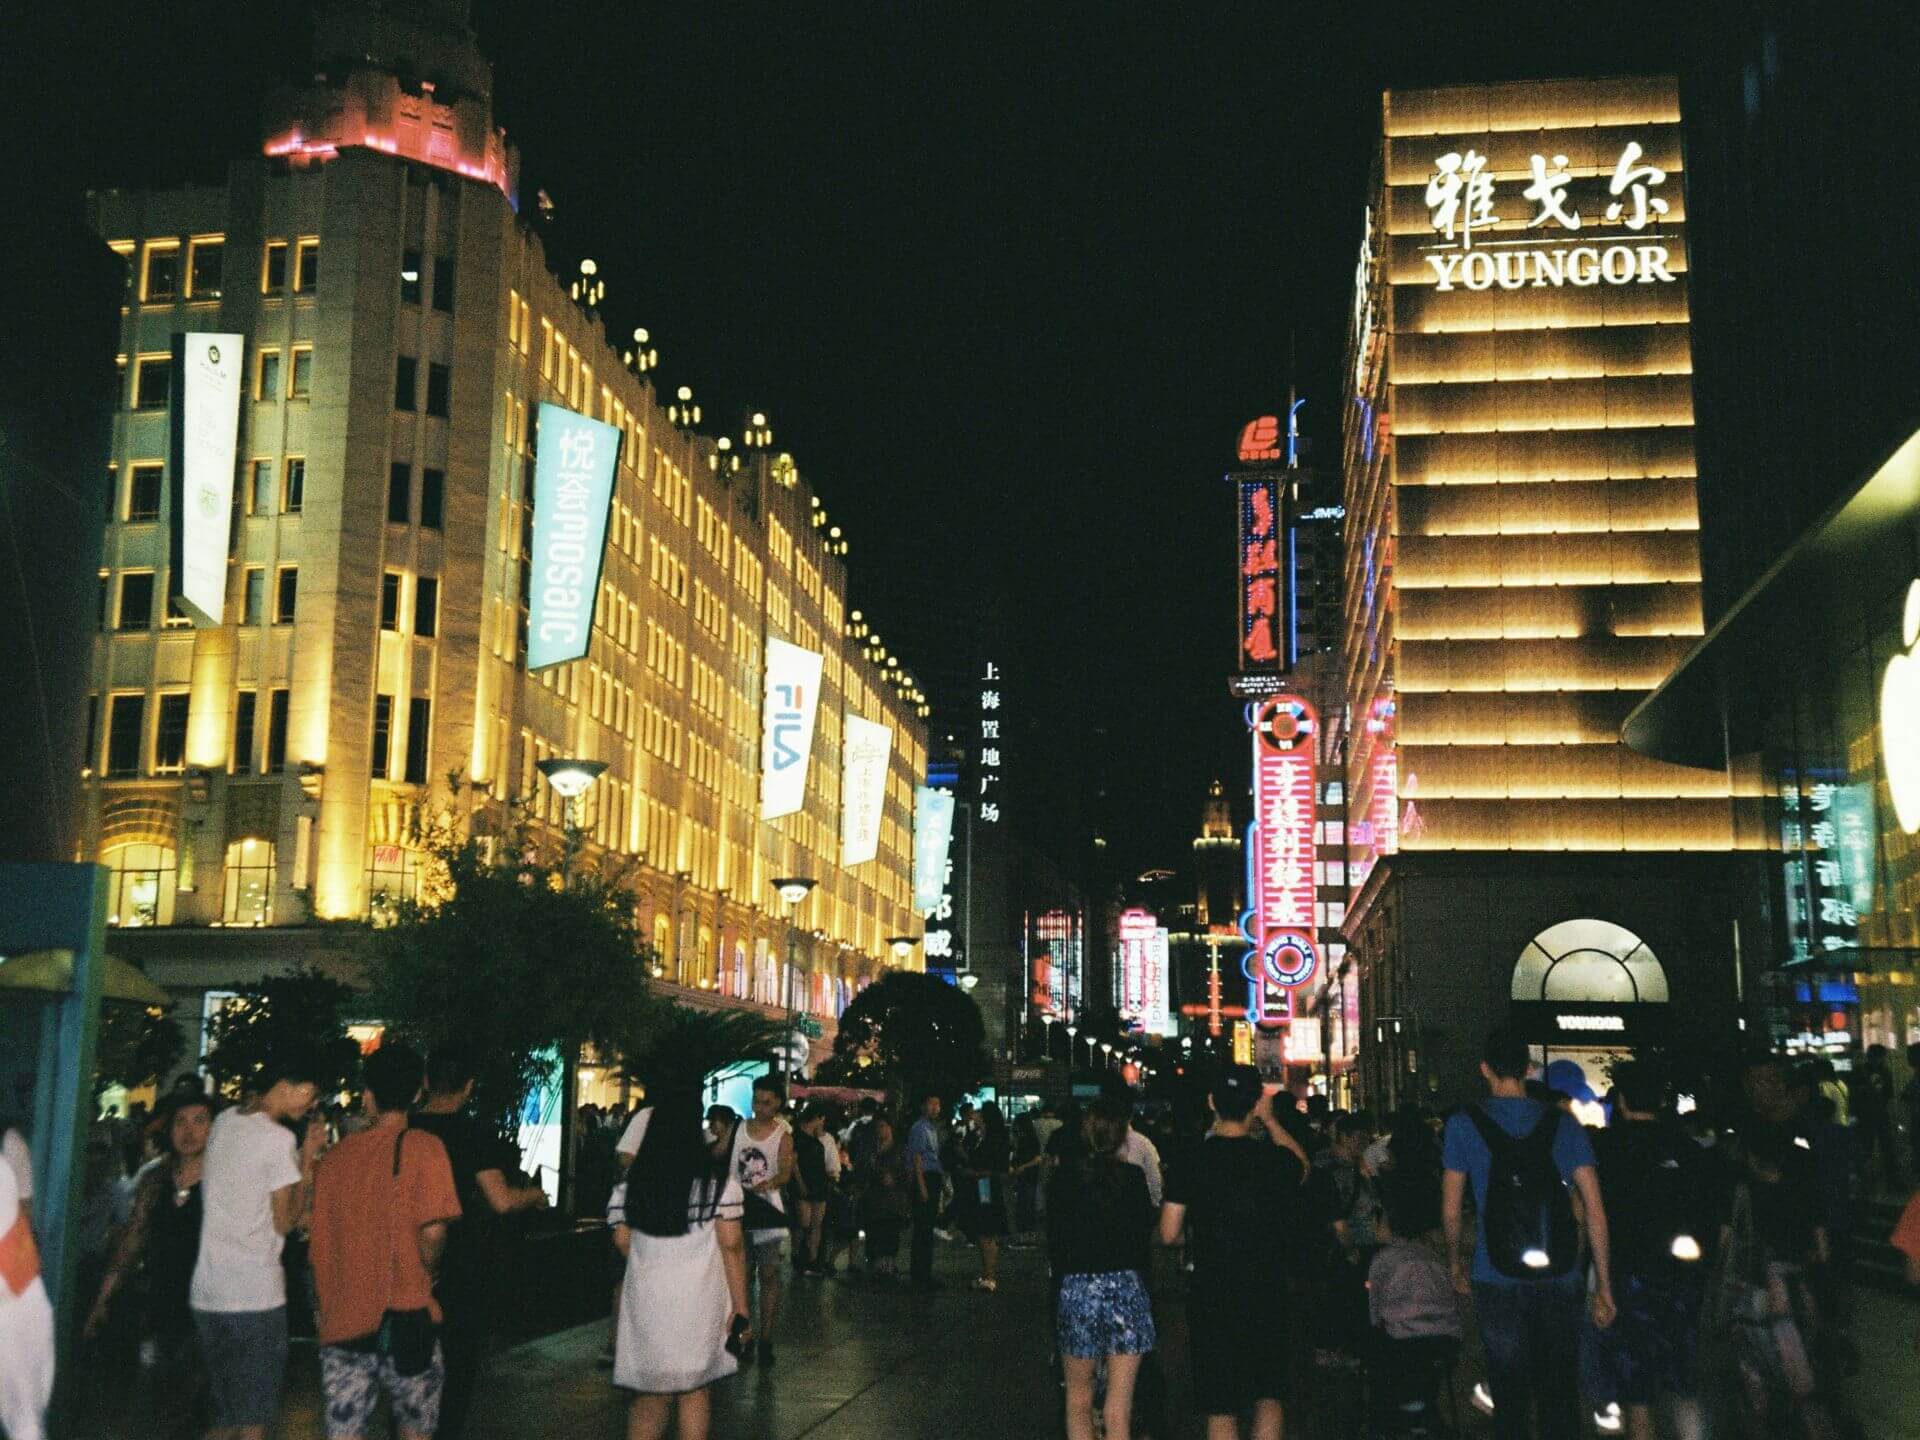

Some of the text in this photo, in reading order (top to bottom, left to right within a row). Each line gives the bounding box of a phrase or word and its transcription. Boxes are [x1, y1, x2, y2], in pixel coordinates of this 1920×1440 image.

[1425, 141, 1669, 250] 雅戈尔
[1425, 245, 1677, 292] YOUNGOR
[772, 684, 803, 771] FILA
[980, 661, 1000, 823] 上海置地广场
